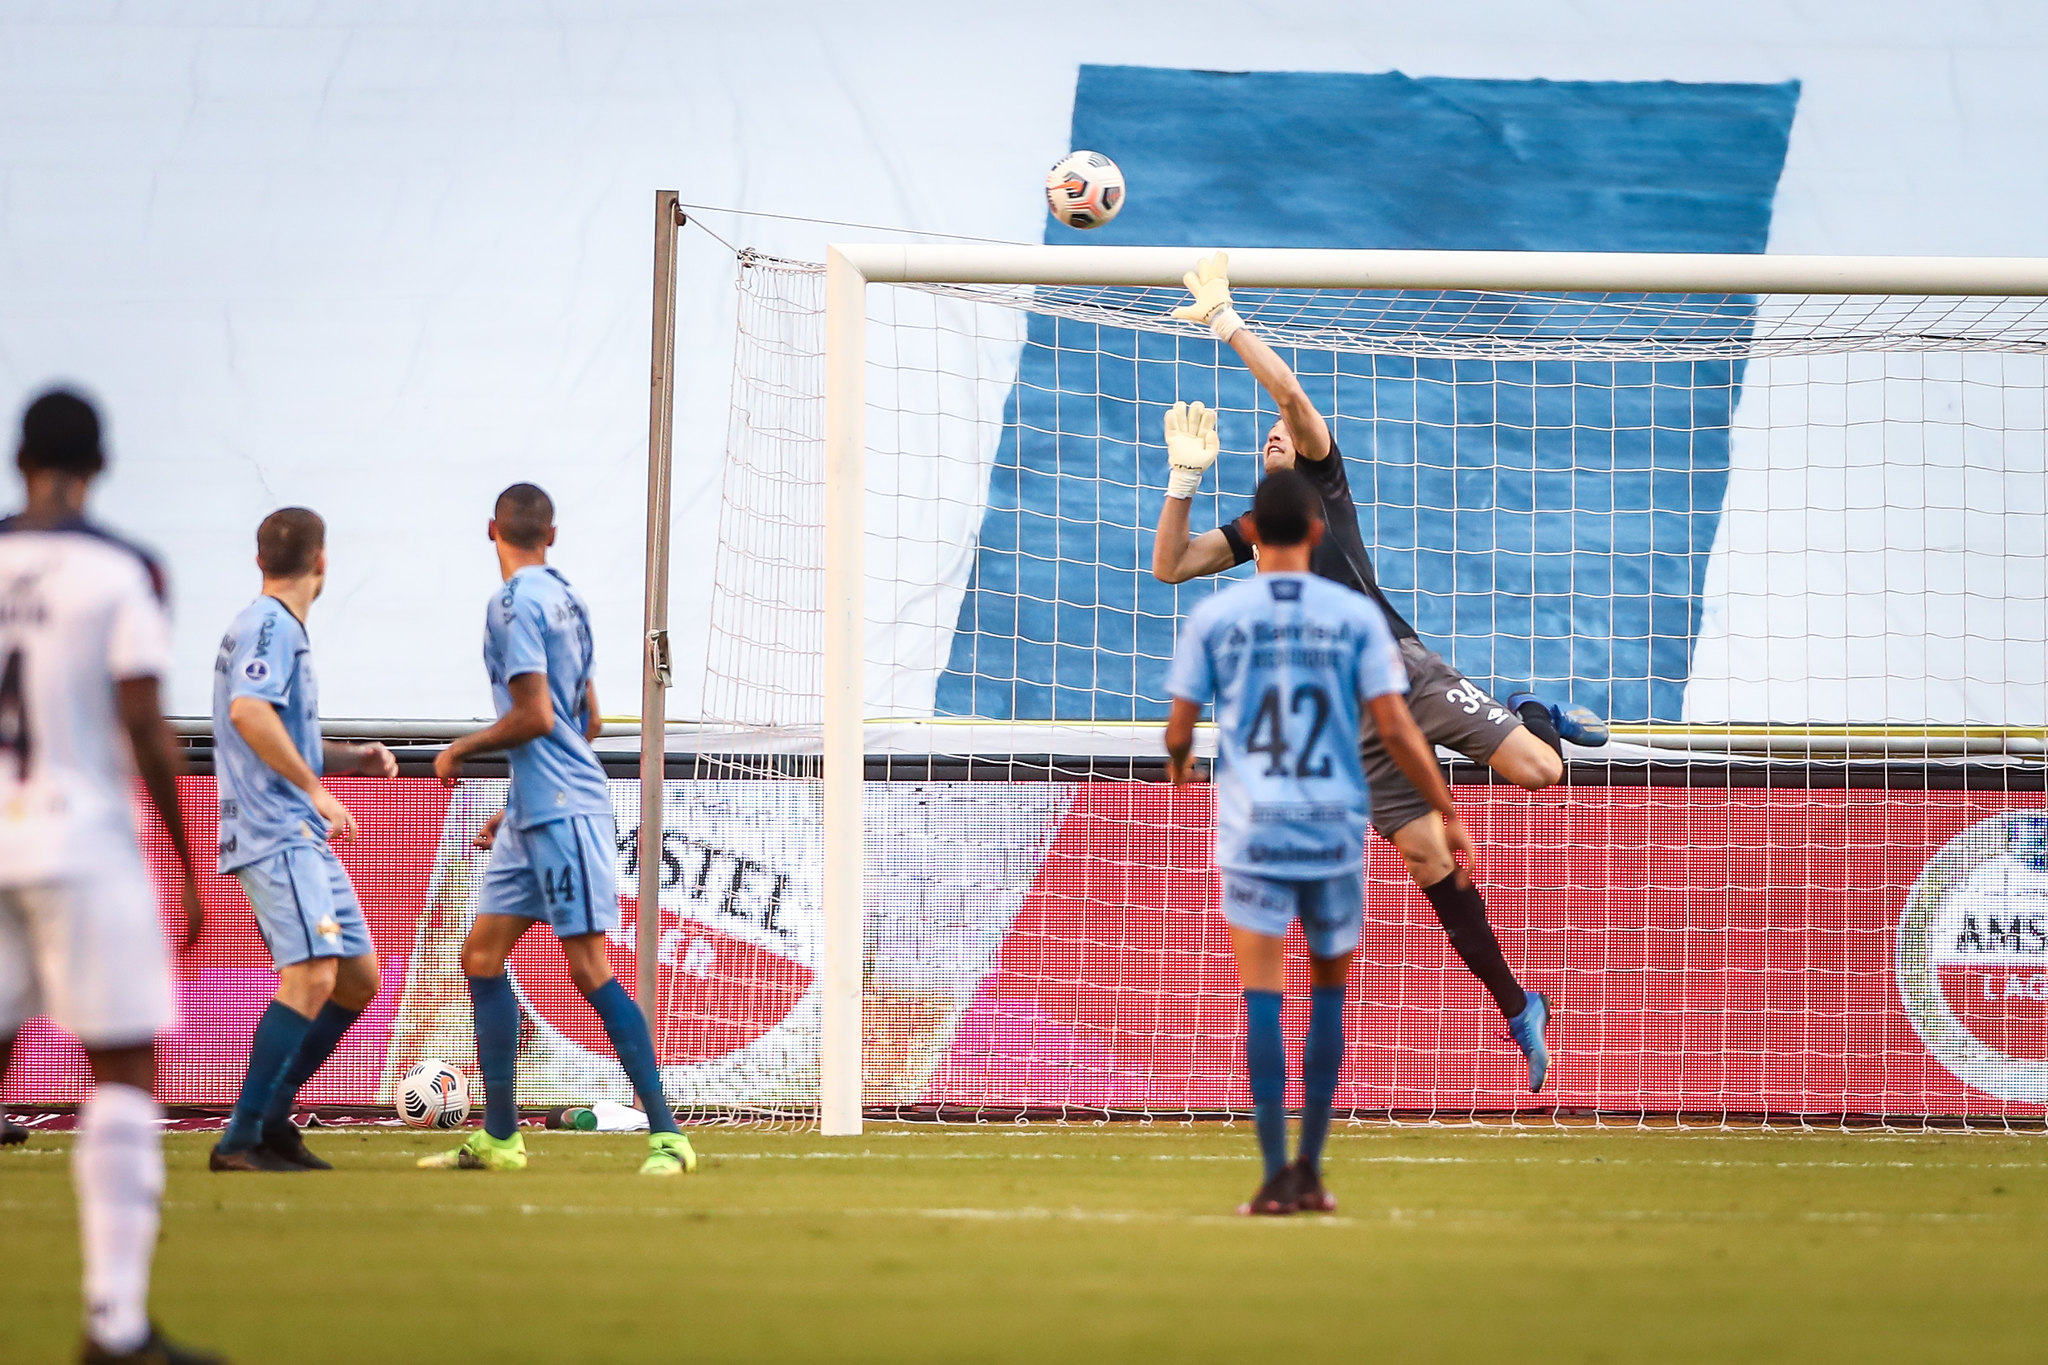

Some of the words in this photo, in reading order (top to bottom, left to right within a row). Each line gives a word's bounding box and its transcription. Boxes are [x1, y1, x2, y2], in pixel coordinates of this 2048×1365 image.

[1247, 683, 1333, 779] 42
[1446, 678, 1490, 715] 34
[614, 826, 795, 938] MSTEL
